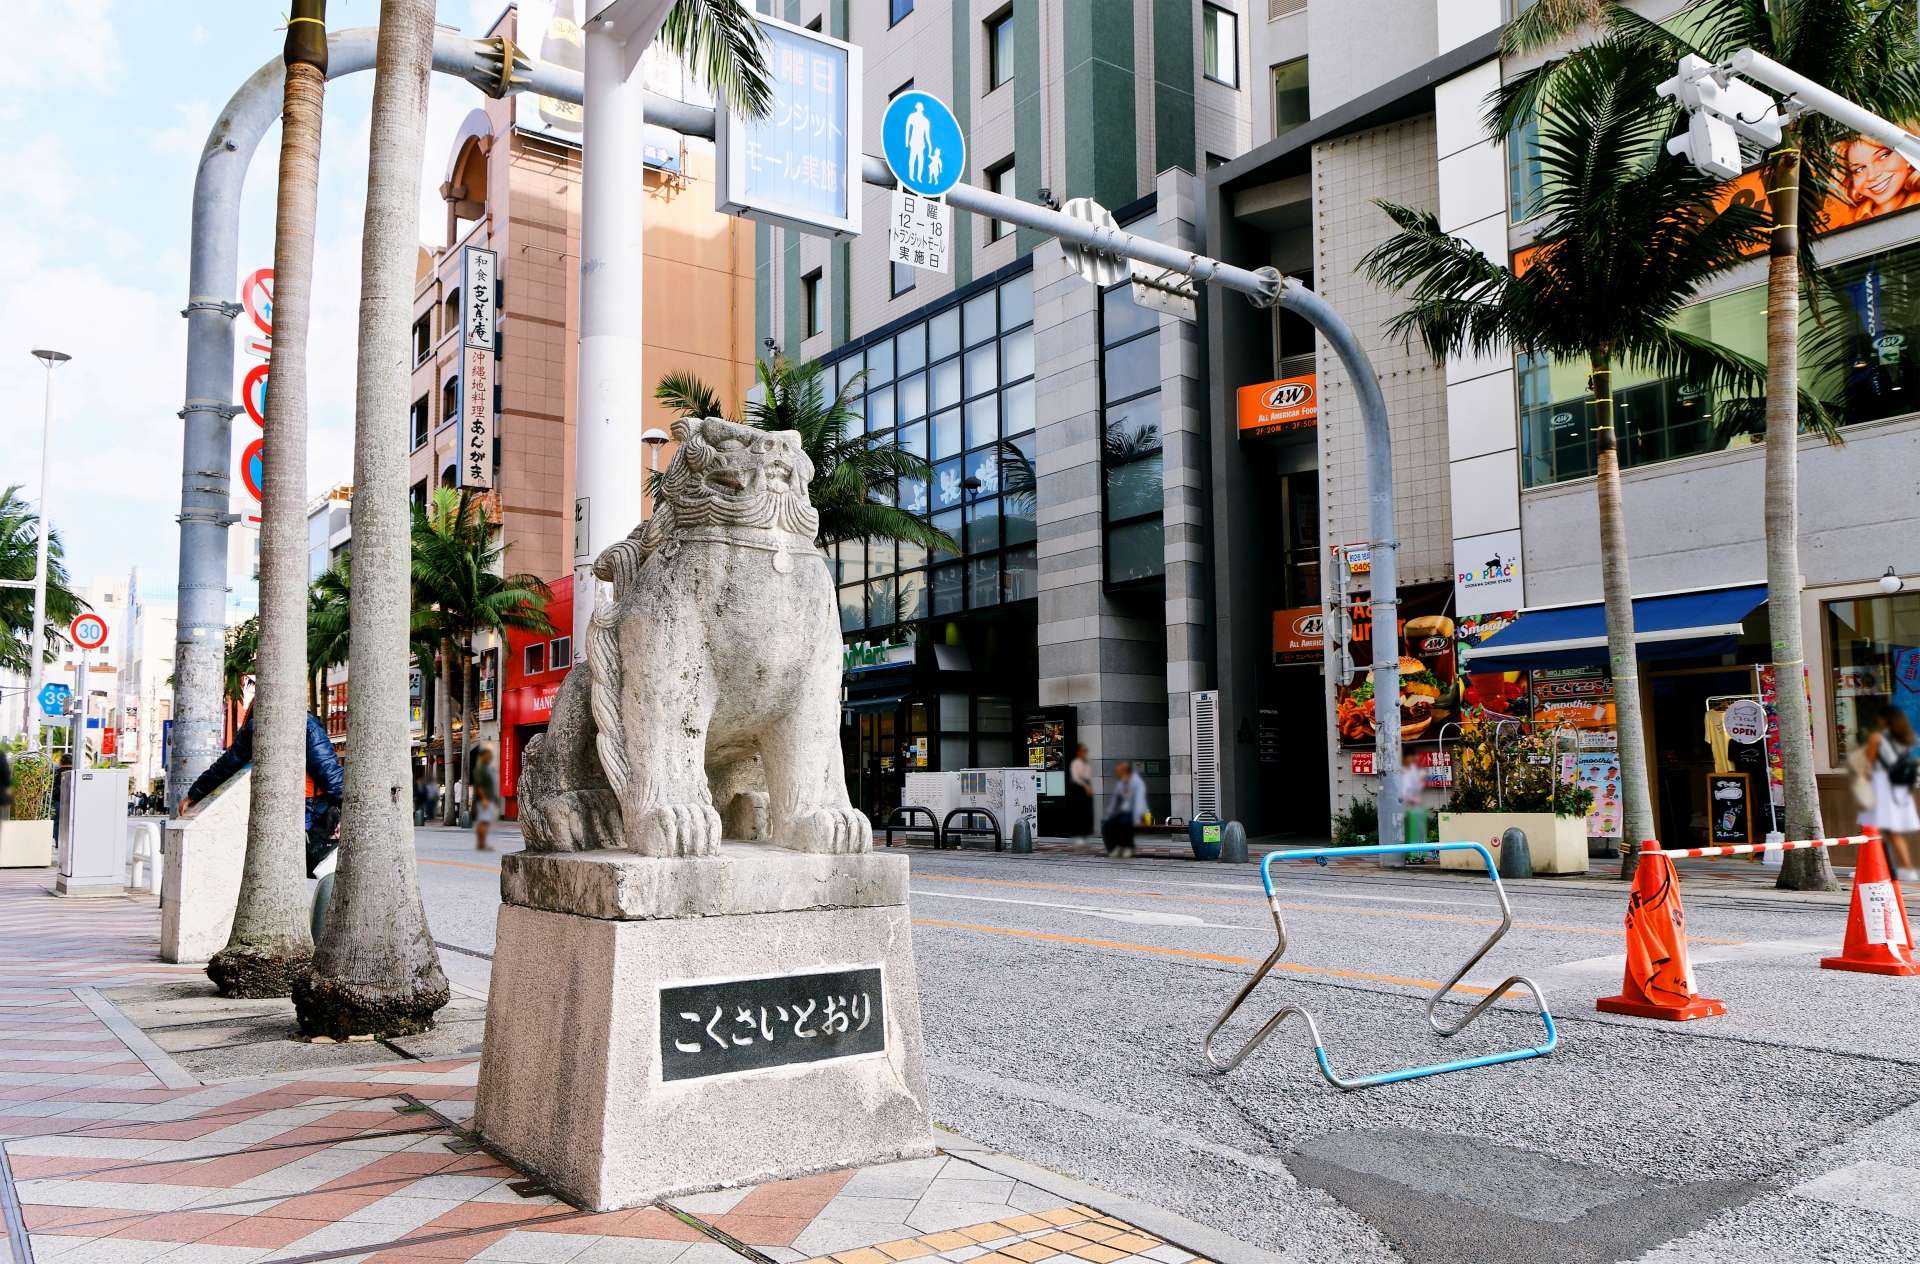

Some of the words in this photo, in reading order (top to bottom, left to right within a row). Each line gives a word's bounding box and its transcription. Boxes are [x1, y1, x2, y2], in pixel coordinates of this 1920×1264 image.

[768, 46, 836, 95] 曜日
[774, 97, 843, 140] ンジット
[904, 197, 939, 220] 日曜
[893, 227, 946, 253] トランジットモール
[475, 255, 488, 282] 和食
[899, 246, 940, 268] 実施日
[471, 351, 487, 419] 沖縄地料理
[1272, 386, 1305, 406] A&W
[470, 419, 486, 480] あんがま
[79, 623, 101, 640] 30
[843, 639, 886, 672] yMart
[44, 691, 67, 706] 39
[1543, 699, 1593, 713] Smoothie
[1732, 727, 1757, 737] OPEN
[674, 992, 871, 1053] こくさいとおり
